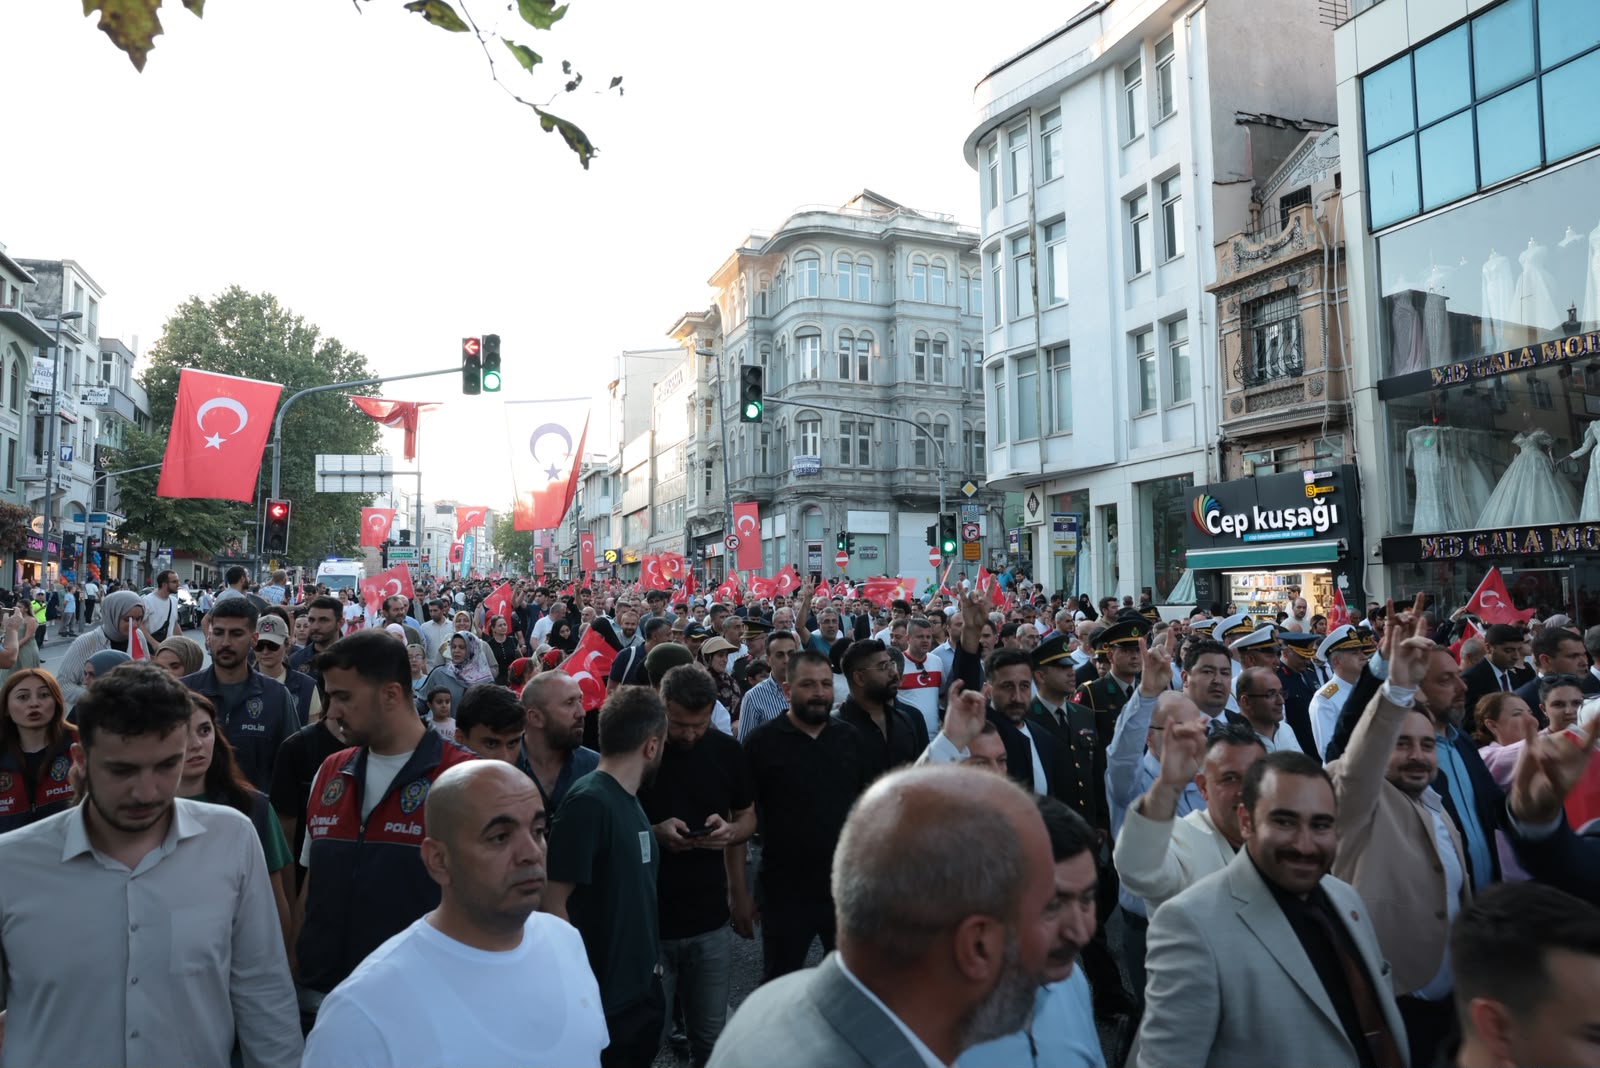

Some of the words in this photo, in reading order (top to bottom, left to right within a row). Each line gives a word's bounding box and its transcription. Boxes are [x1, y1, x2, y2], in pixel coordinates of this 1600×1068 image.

[1206, 510, 1248, 538] Cep
[1252, 497, 1339, 532] kuşağı
[241, 723, 265, 732] POLİS
[46, 783, 76, 797] POLİS
[384, 821, 422, 835] POLİS
